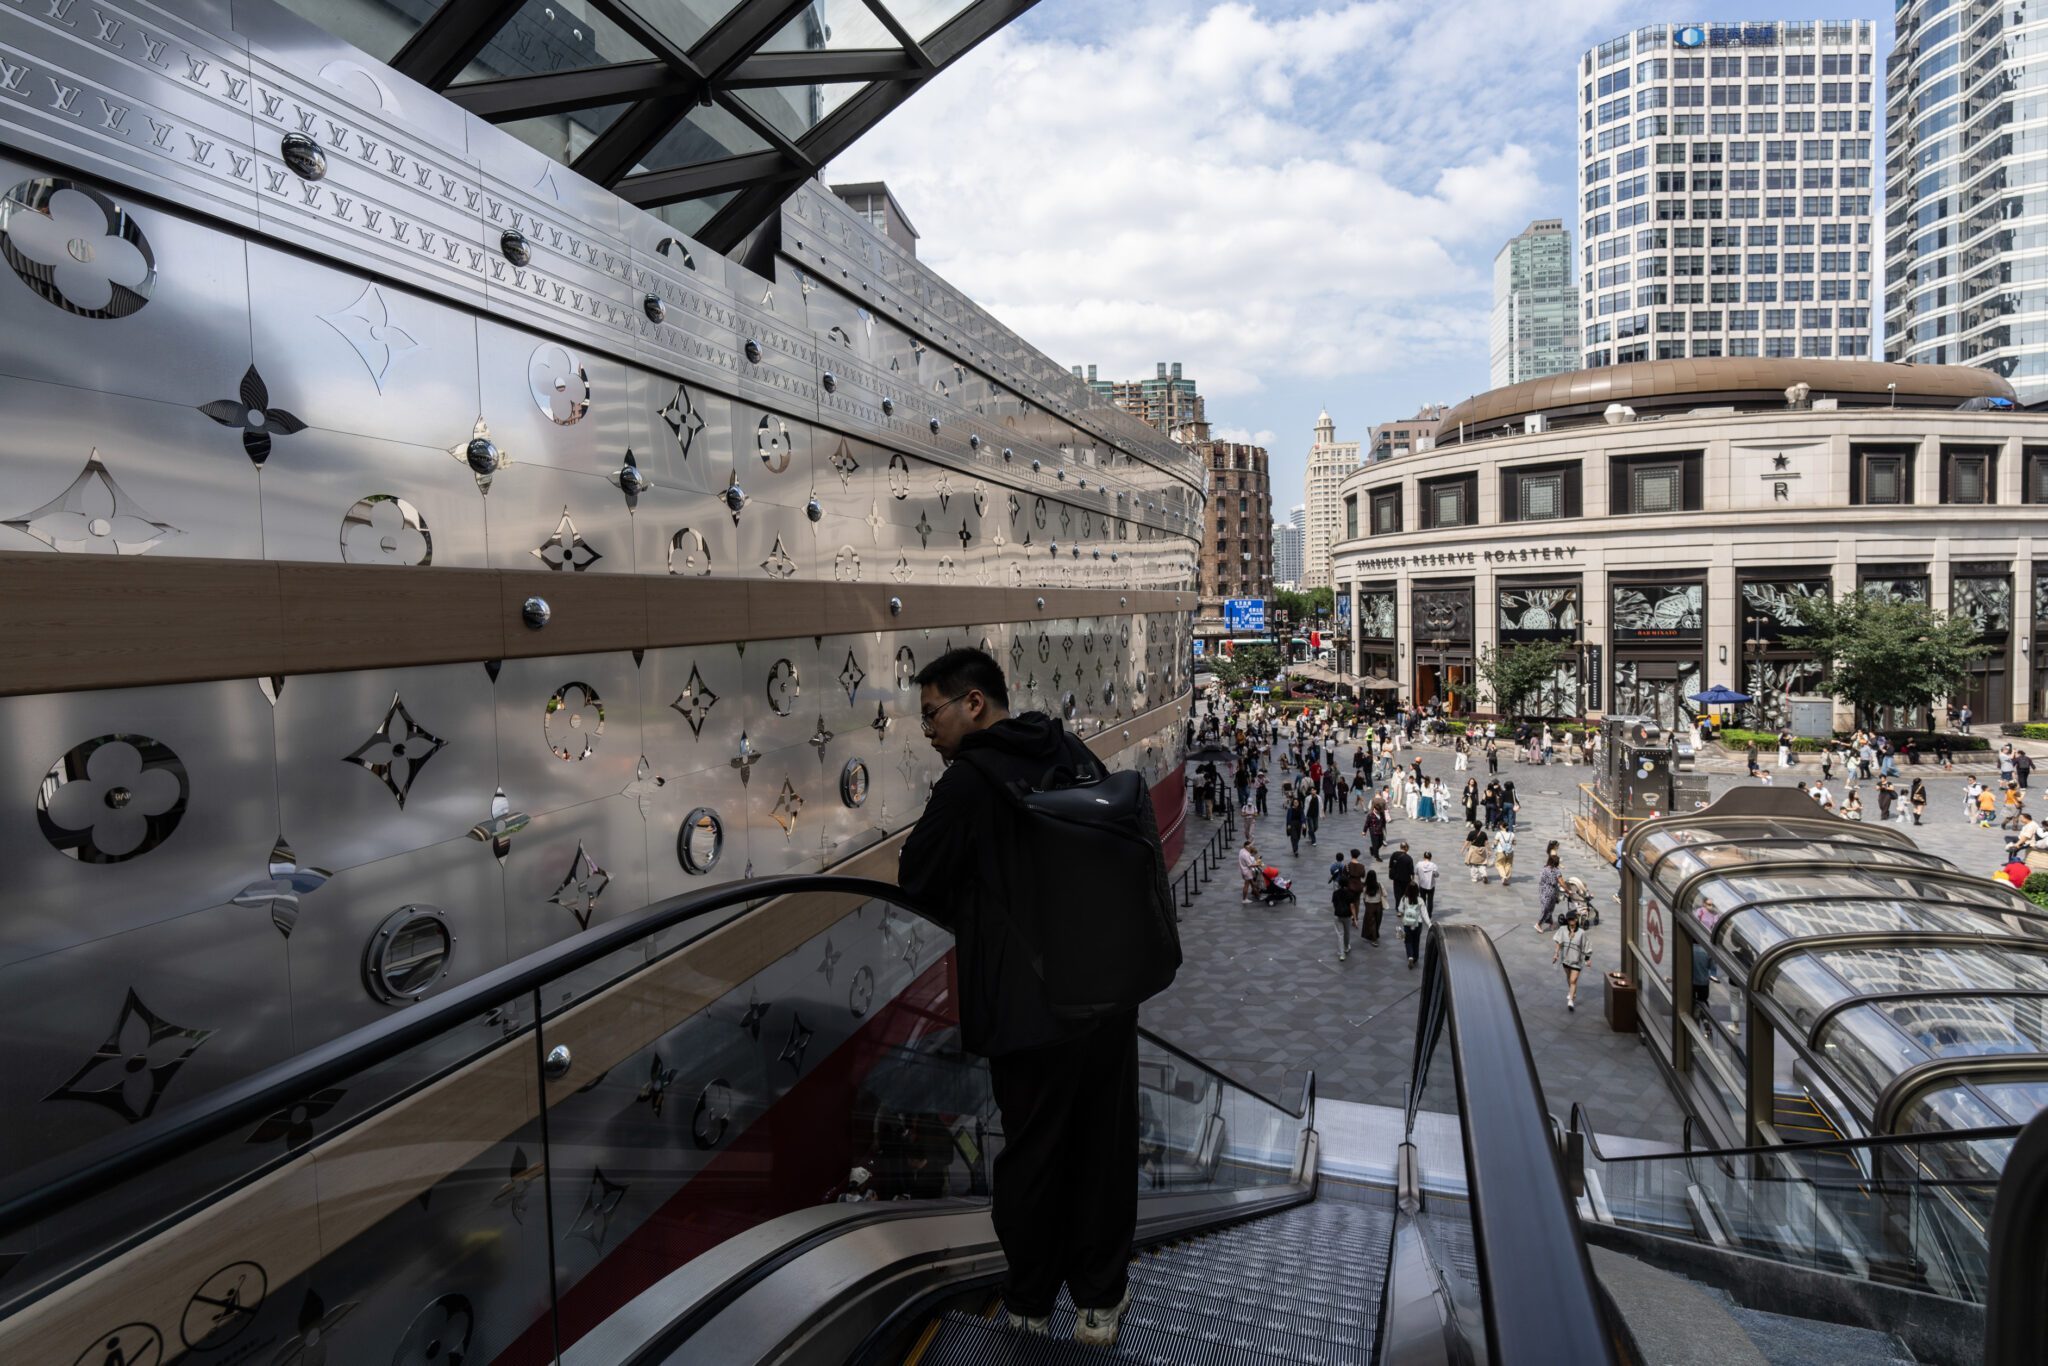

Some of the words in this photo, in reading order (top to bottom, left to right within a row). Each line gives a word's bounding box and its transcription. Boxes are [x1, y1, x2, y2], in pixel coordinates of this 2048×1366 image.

[48, 76, 83, 117] LV
[97, 97, 131, 136] LV
[143, 114, 174, 153] LV
[185, 132, 215, 169] LV
[225, 148, 252, 183] LV
[263, 164, 288, 197] LV
[297, 178, 321, 210] LV
[330, 192, 352, 222] LV
[361, 204, 382, 234] LV
[389, 216, 409, 244] LV
[416, 227, 435, 254] LV
[442, 237, 460, 264] LV
[466, 247, 483, 273] LV
[490, 257, 505, 281] LV
[512, 266, 527, 290] LV
[532, 274, 546, 298] LV
[551, 282, 566, 305] LV
[570, 290, 583, 312] LV
[91, 8, 125, 50] LV
[138, 30, 169, 69] LV
[180, 50, 210, 88] LV
[220, 69, 248, 106] LV
[258, 88, 284, 122] LV
[293, 104, 317, 137] LV
[325, 120, 349, 152] LV
[357, 135, 378, 165] LV
[386, 149, 406, 178] LV
[413, 162, 432, 190] LV
[439, 174, 456, 202] LV
[463, 186, 480, 212] LV
[486, 197, 503, 223] LV
[508, 208, 524, 232] LV
[530, 218, 544, 241] LV
[549, 227, 563, 250] LV
[568, 236, 581, 258] LV
[585, 244, 598, 266] LV
[1774, 482, 1789, 501] R
[1356, 556, 1406, 571] STARBUCKS
[1413, 552, 1475, 566] RESERVE
[1484, 546, 1576, 562] ROASTERY
